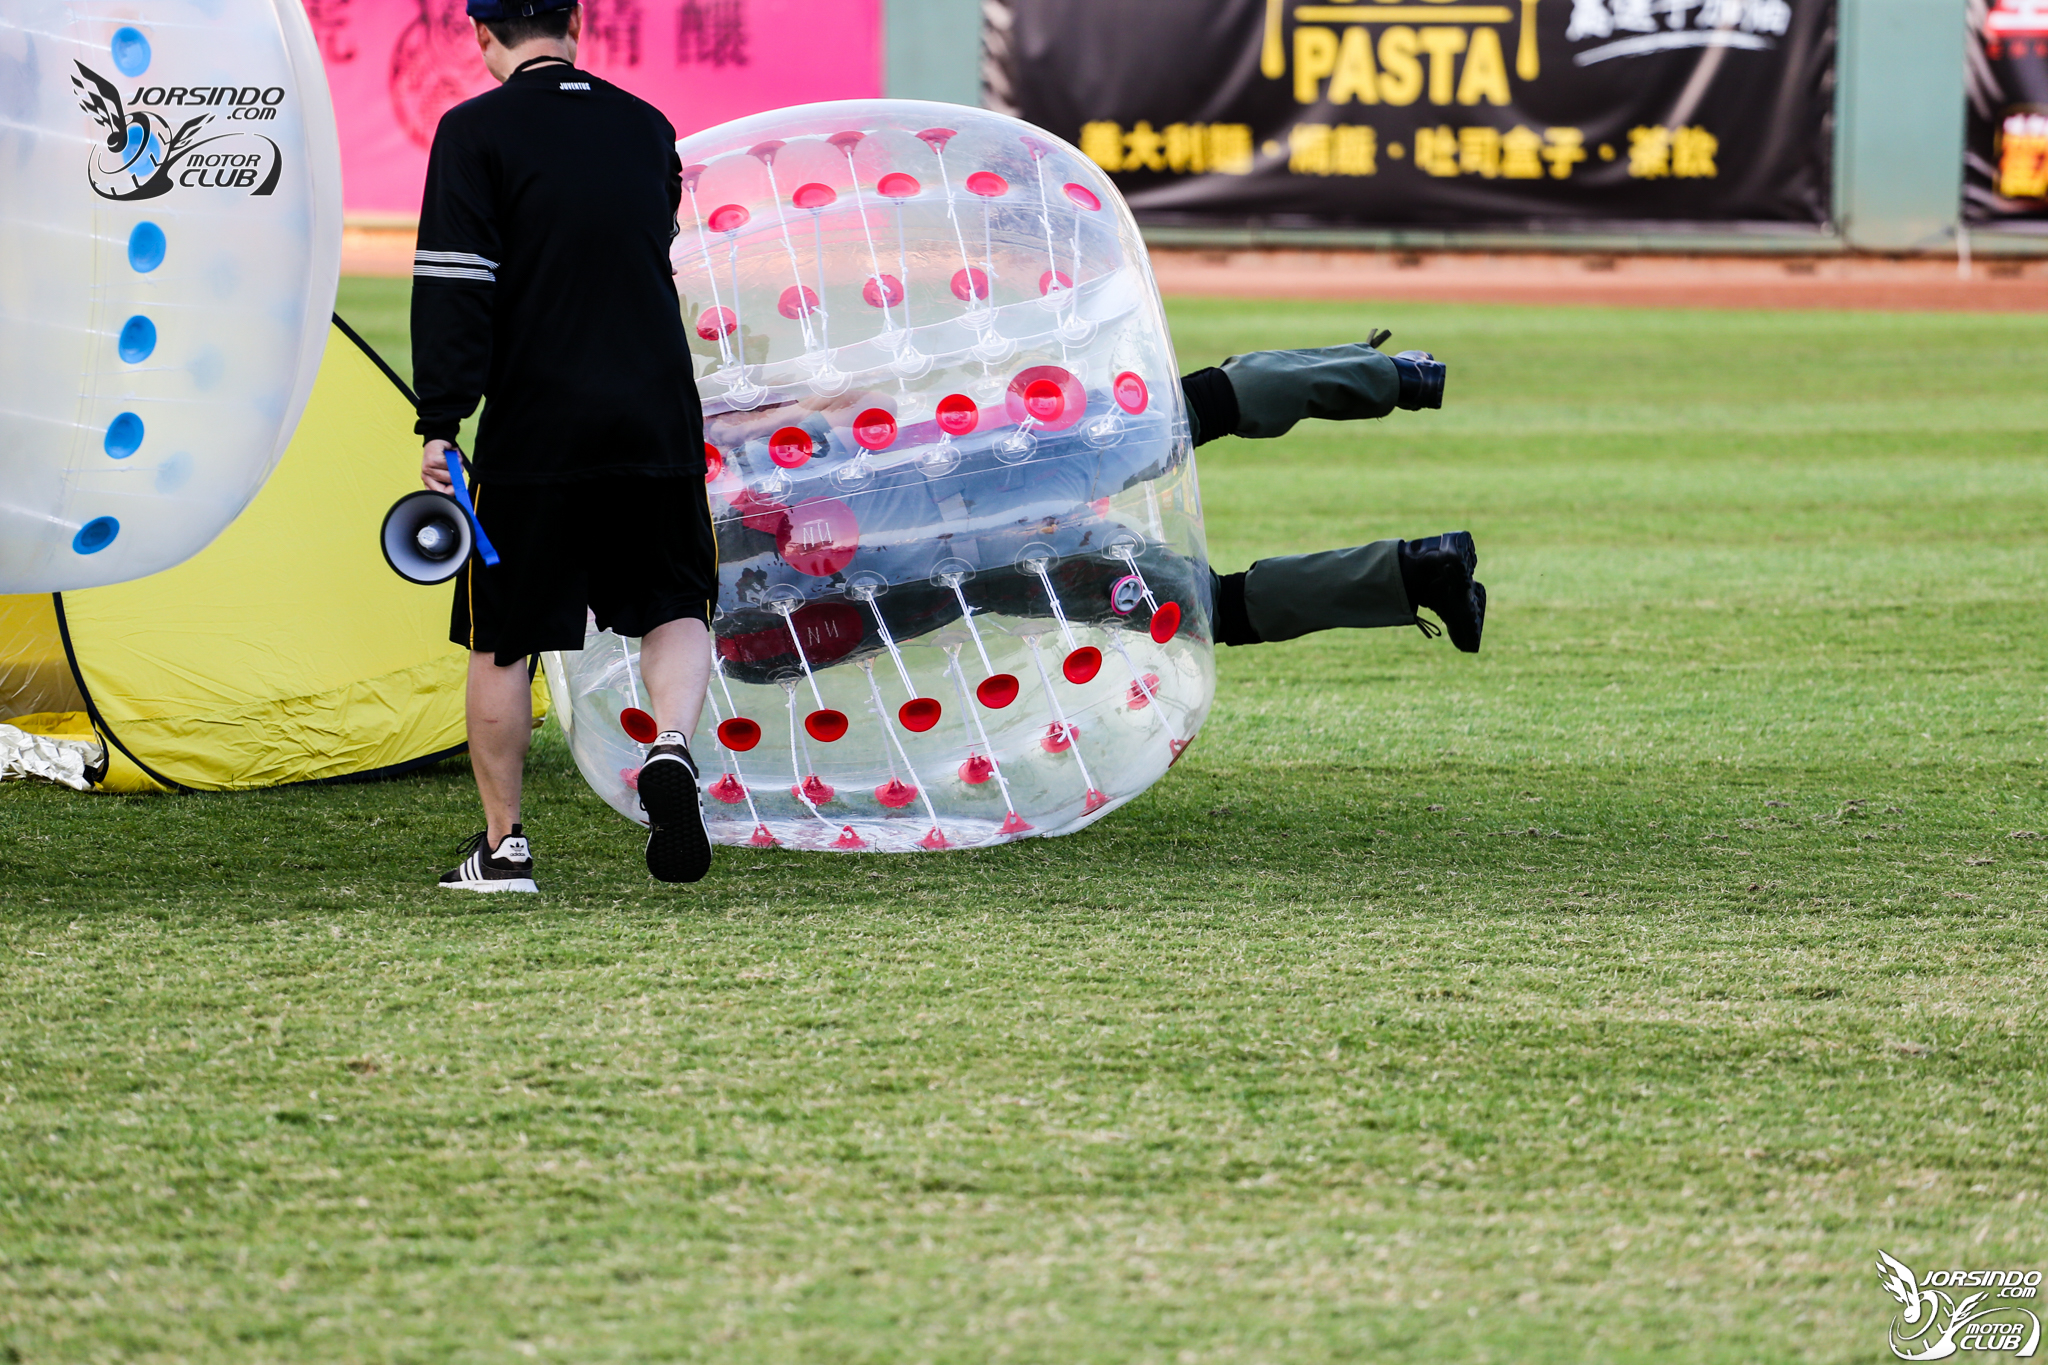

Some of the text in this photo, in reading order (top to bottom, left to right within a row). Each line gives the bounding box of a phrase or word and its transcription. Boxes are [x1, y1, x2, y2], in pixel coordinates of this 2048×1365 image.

[559, 82, 591, 91] JUVENTUS
[1293, 25, 1512, 106] PASTA
[1414, 125, 1587, 179] 吐司盒子
